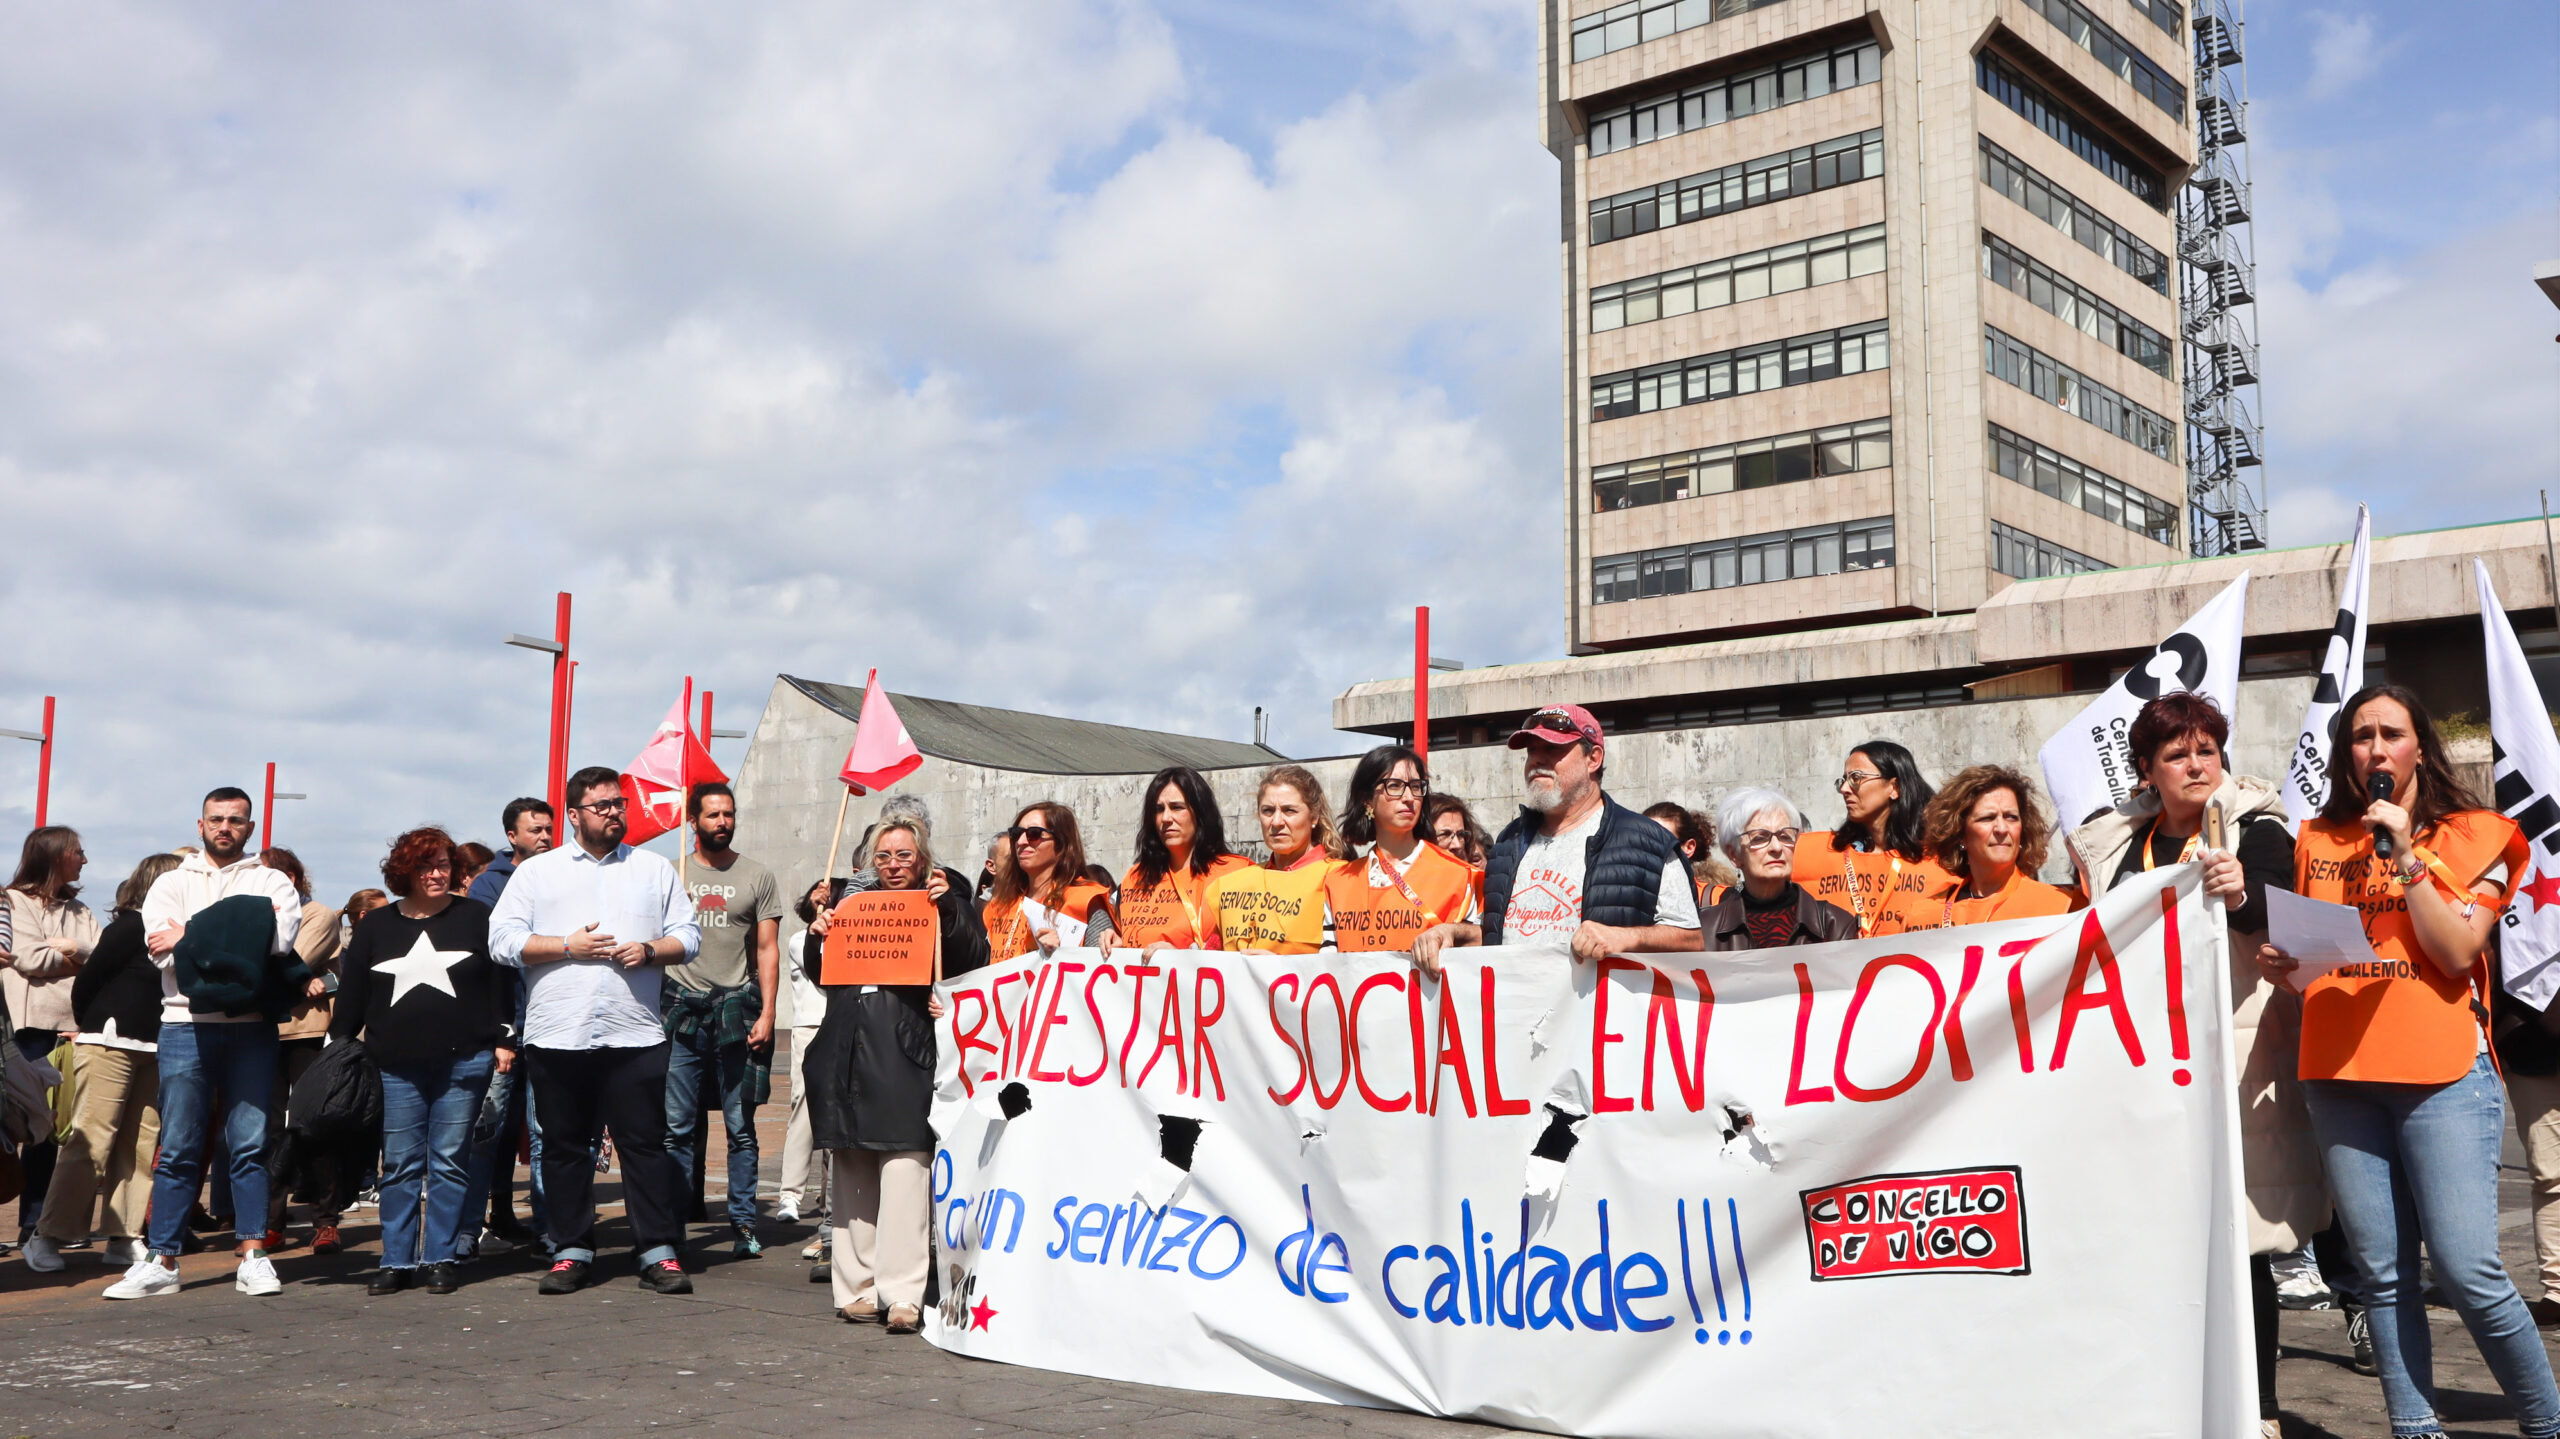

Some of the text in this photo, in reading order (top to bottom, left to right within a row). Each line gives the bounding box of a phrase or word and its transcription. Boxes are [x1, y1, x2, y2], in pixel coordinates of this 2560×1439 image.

[2091, 726, 2106, 743] de
[689, 880, 736, 901] keep
[2347, 882, 2389, 896] VIGO
[859, 901, 906, 911] UN AÑO
[1131, 905, 1160, 915] VIGO
[1505, 899, 1565, 926] Originals
[833, 918, 929, 927] REIVINDICANDO
[1375, 909, 1423, 930] SOCIAIS
[846, 934, 913, 943] Y NINGUNA
[847, 948, 909, 959] SOLUCIÓN
[1267, 966, 1531, 1118] SOCIAL
[1592, 957, 1715, 1113] EN
[1784, 886, 2192, 1106] LOITA!
[1811, 1185, 2006, 1222] CONCELLO
[1821, 1232, 1867, 1268] DE
[1046, 1196, 1247, 1280] servizo
[1275, 1184, 1354, 1303] de
[1382, 1197, 1754, 1346] calidade!!!
